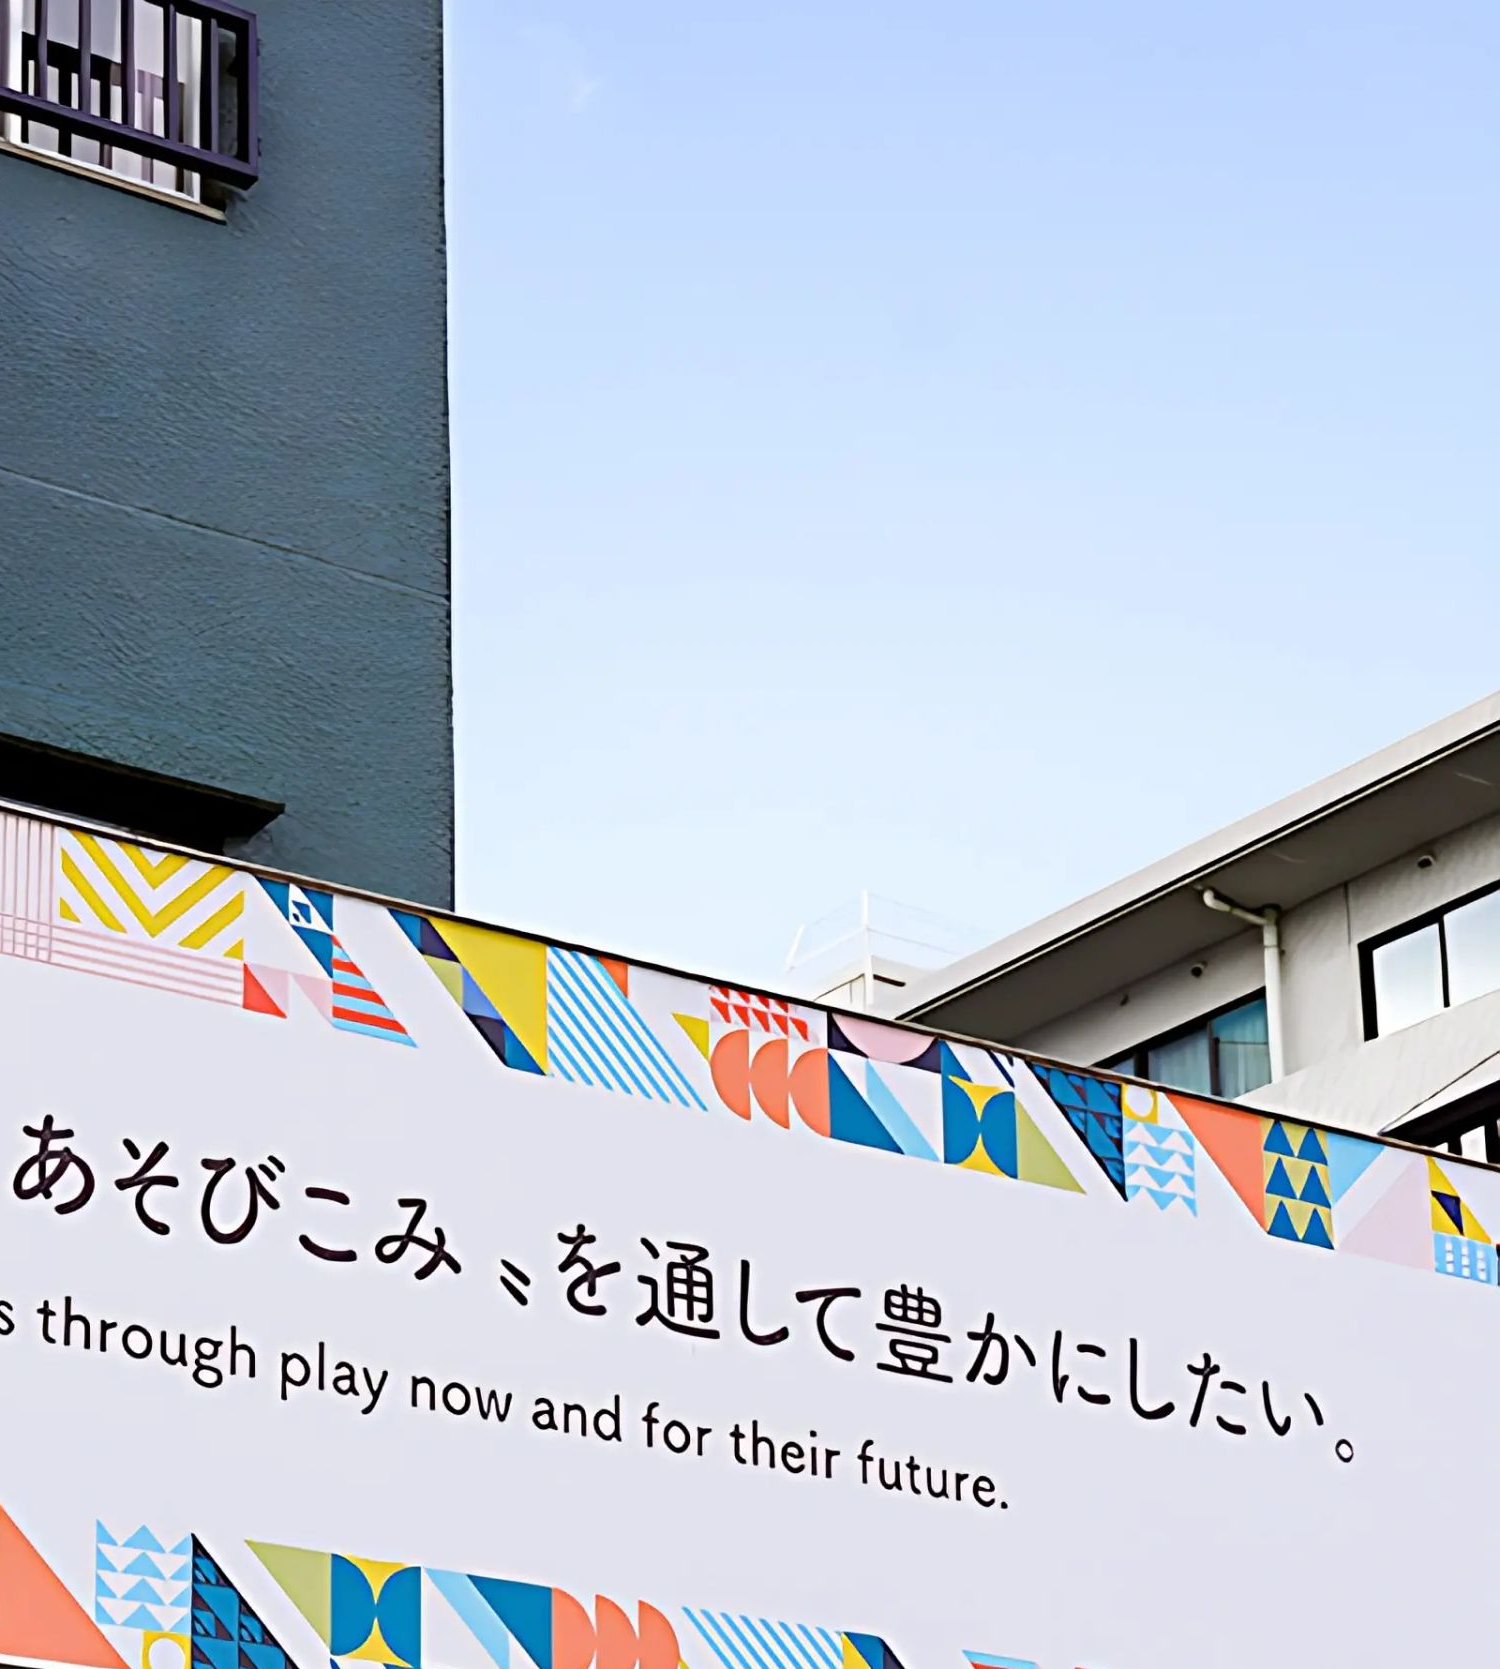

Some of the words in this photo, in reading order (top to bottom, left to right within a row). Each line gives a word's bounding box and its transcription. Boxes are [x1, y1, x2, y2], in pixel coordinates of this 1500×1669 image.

[35, 1294, 257, 1390] through
[279, 1340, 390, 1416] play
[410, 1374, 514, 1424] now
[530, 1393, 623, 1444] and
[640, 1400, 714, 1458] for
[728, 1418, 842, 1480] their
[856, 1438, 1010, 1511] future.
